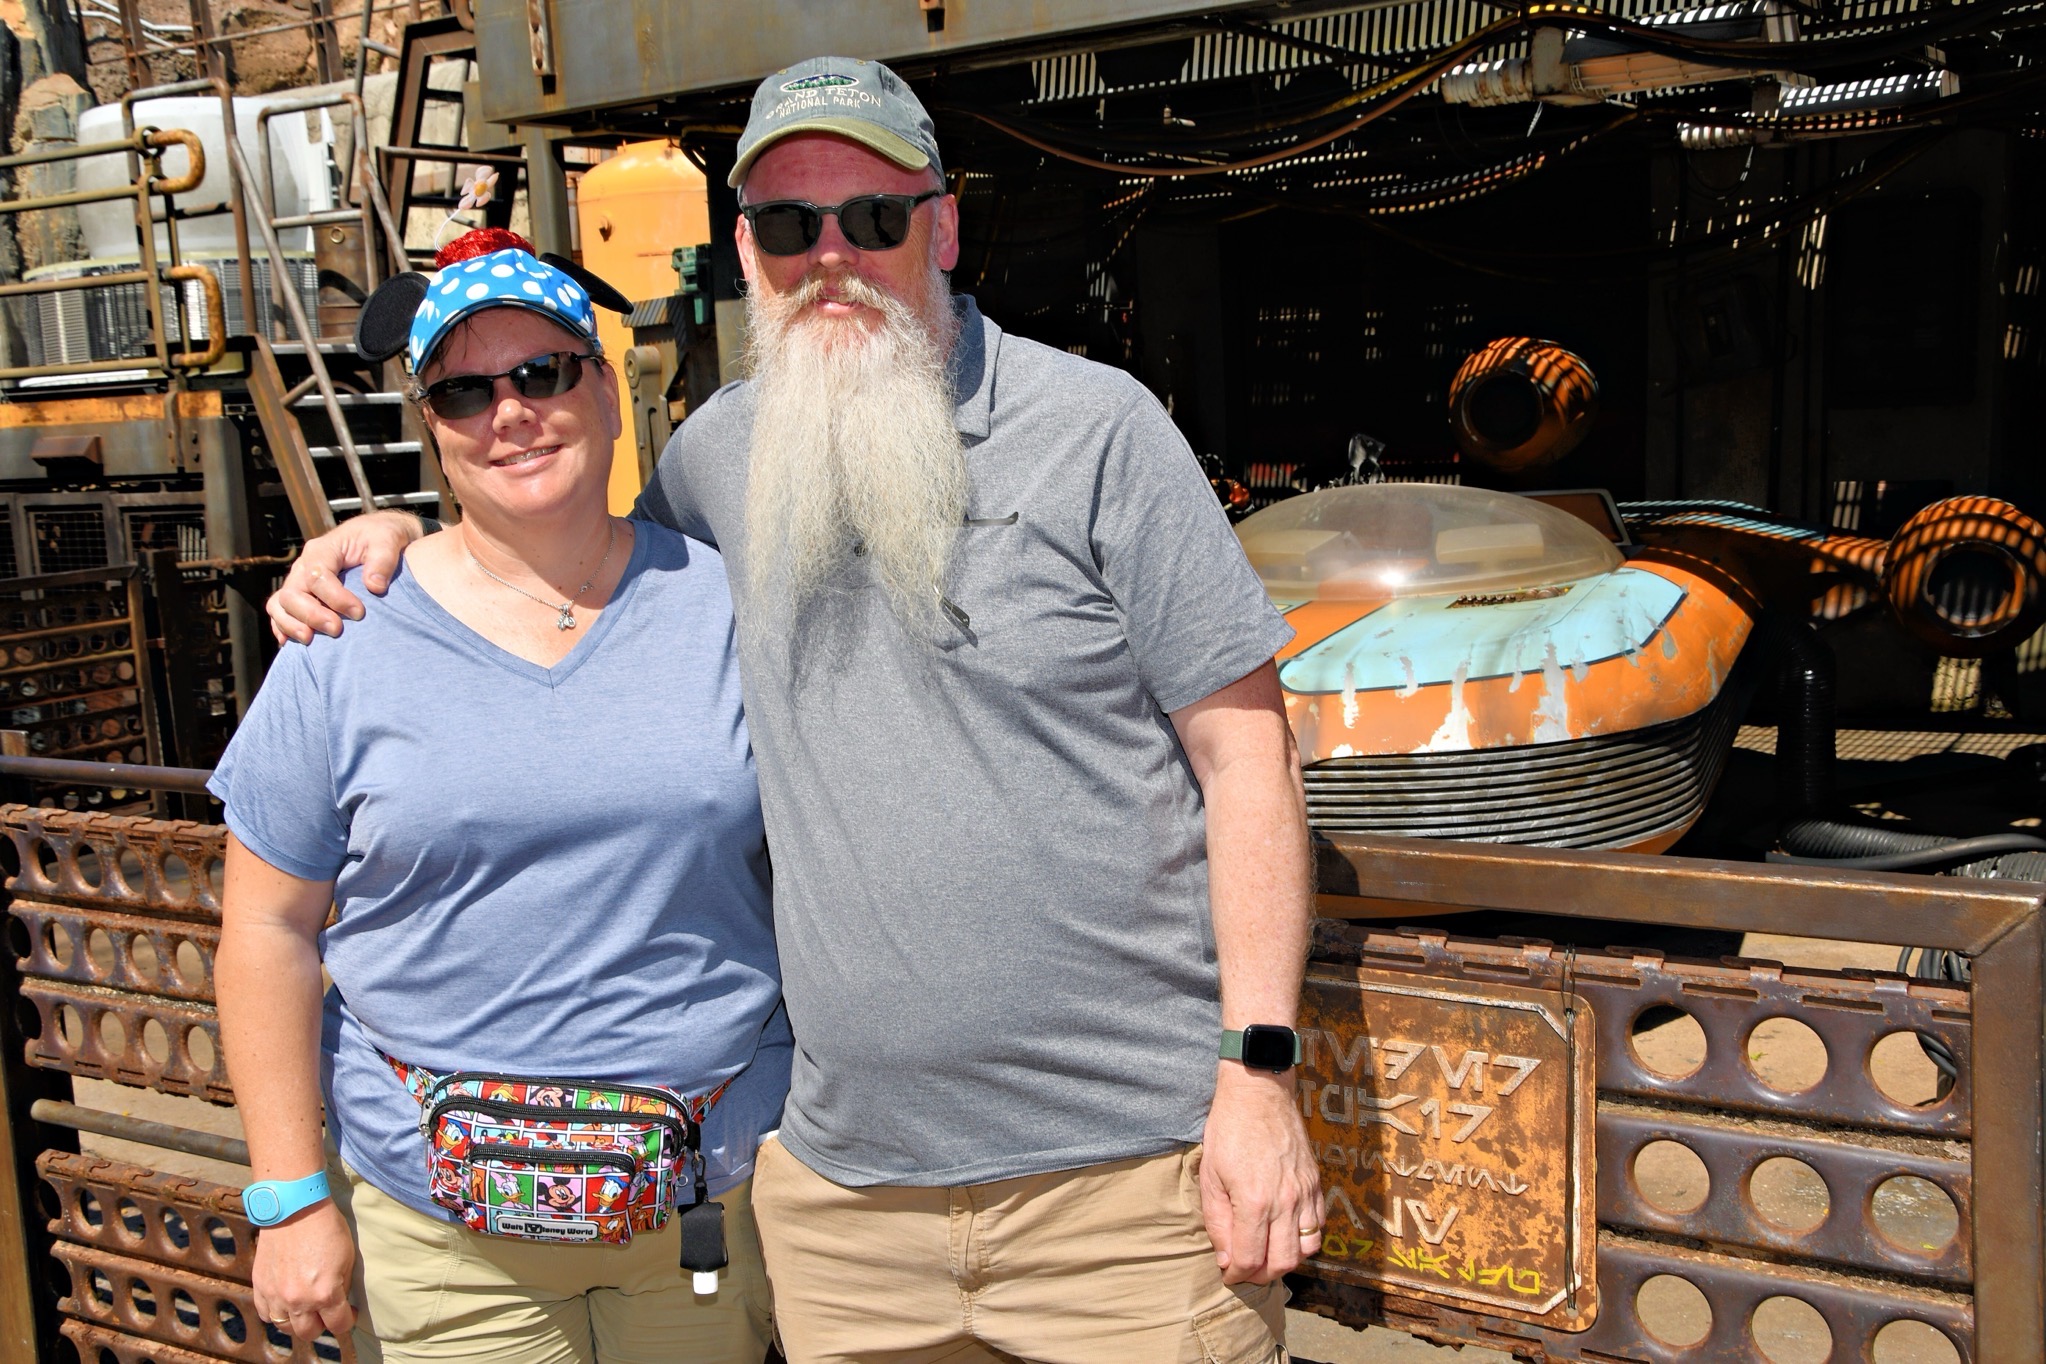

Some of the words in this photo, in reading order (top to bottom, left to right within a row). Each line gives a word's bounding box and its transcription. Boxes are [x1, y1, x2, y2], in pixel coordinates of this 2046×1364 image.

[779, 96, 829, 118] NATIONAL
[833, 96, 860, 109] PARK
[825, 87, 881, 108] TETON
[502, 1223, 523, 1231] Walt
[567, 1228, 593, 1236] World
